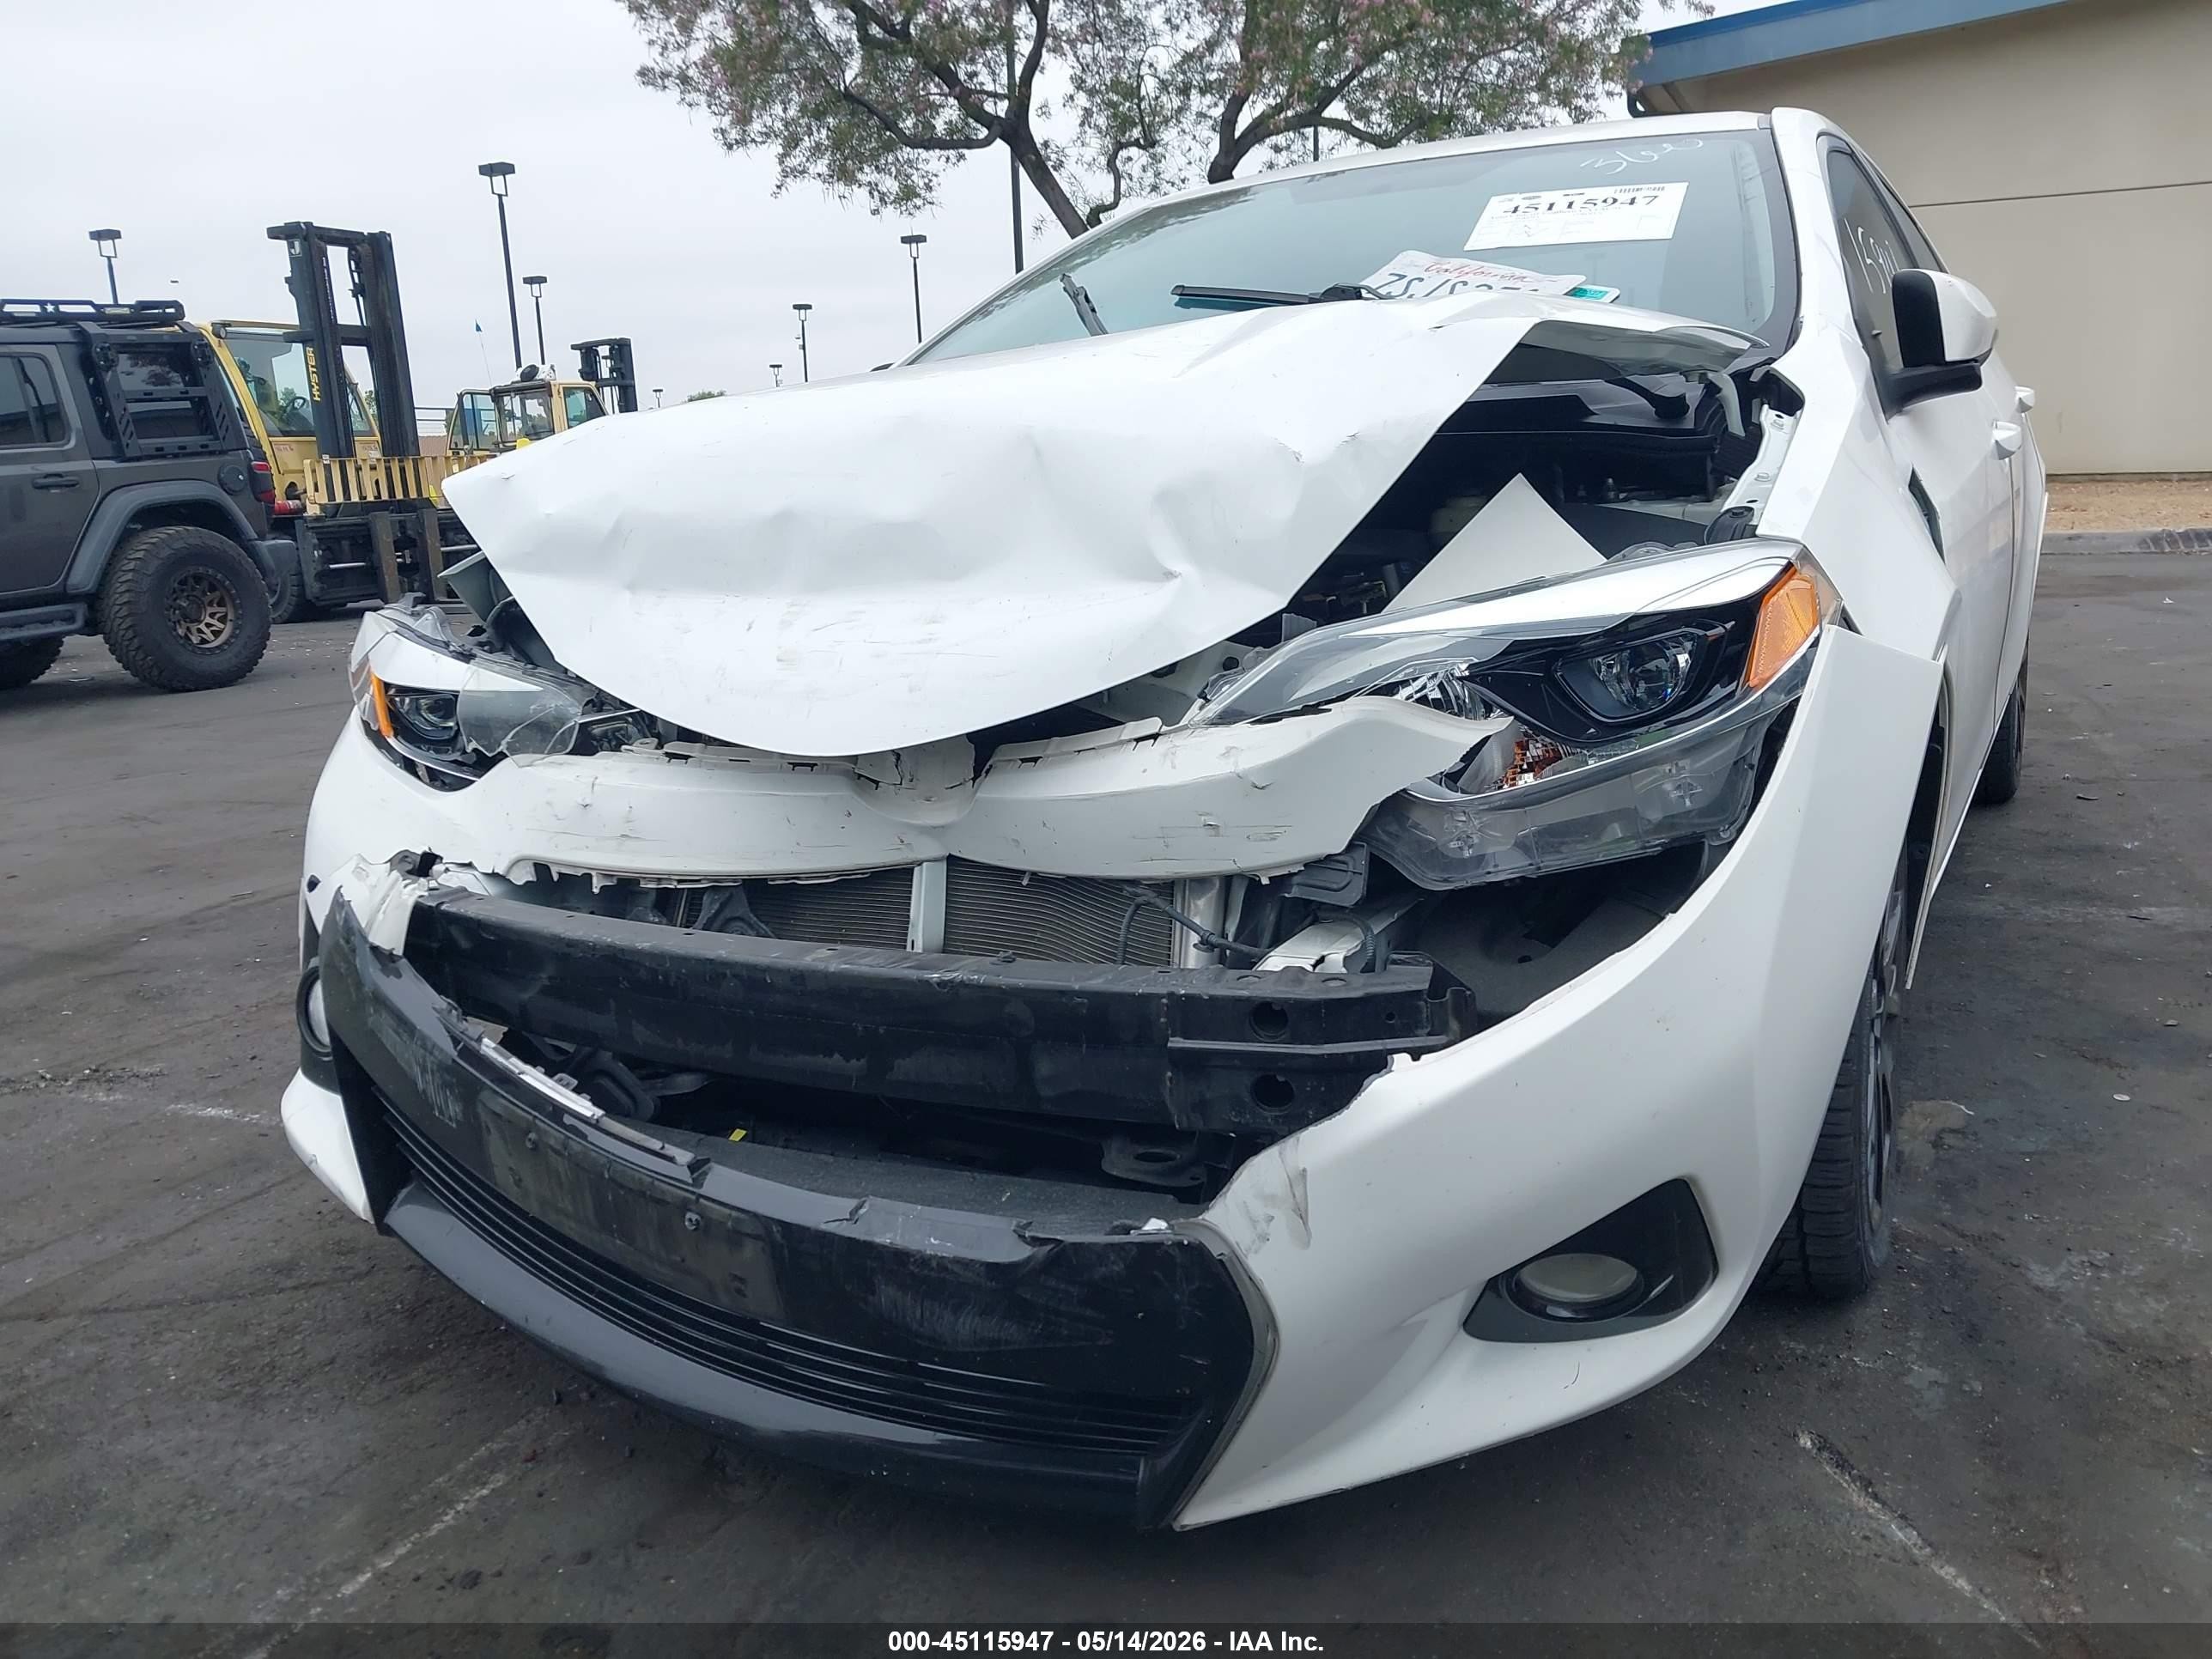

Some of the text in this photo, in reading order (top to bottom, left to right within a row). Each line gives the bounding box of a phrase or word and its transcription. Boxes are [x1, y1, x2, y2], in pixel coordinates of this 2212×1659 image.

[1503, 195, 1660, 215] 45115947
[1424, 261, 1535, 283] California
[306, 346, 321, 402] HYSTER
